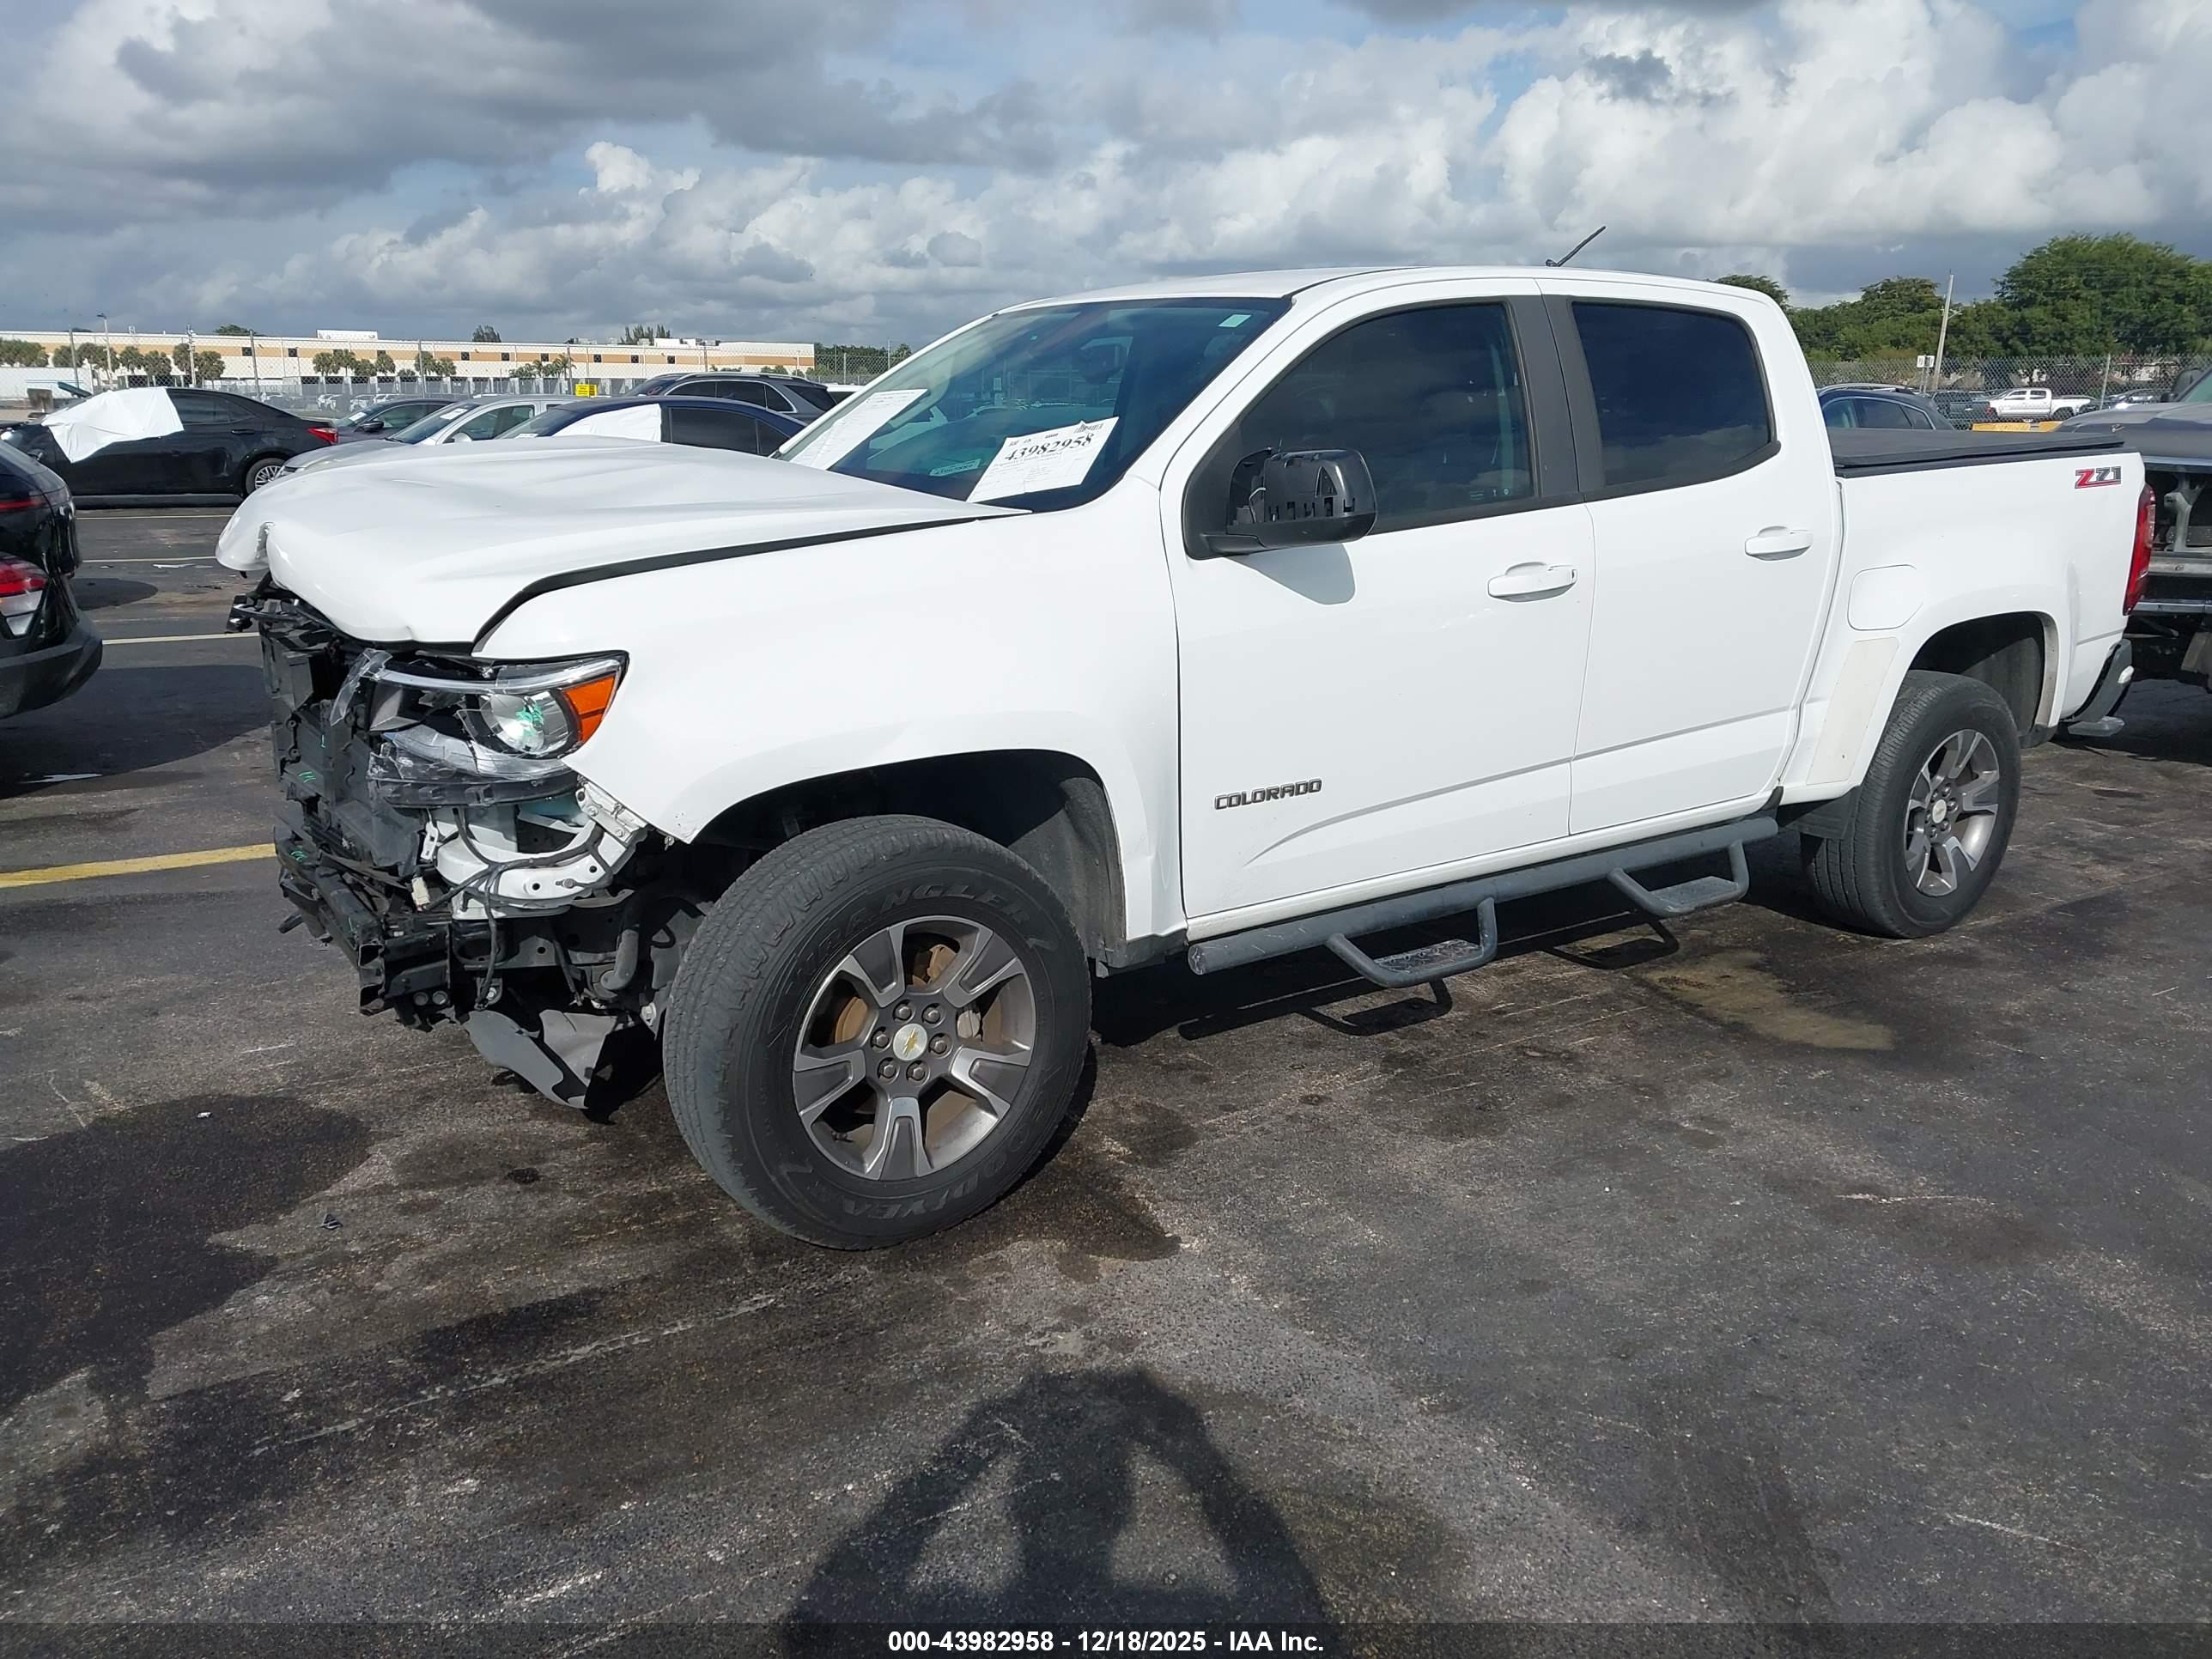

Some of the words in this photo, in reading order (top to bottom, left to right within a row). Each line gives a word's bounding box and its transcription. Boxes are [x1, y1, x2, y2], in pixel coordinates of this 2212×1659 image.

[1005, 433, 1096, 461] 43982958
[2075, 466, 2122, 489] Z71
[1214, 778, 1323, 810] COLORADO
